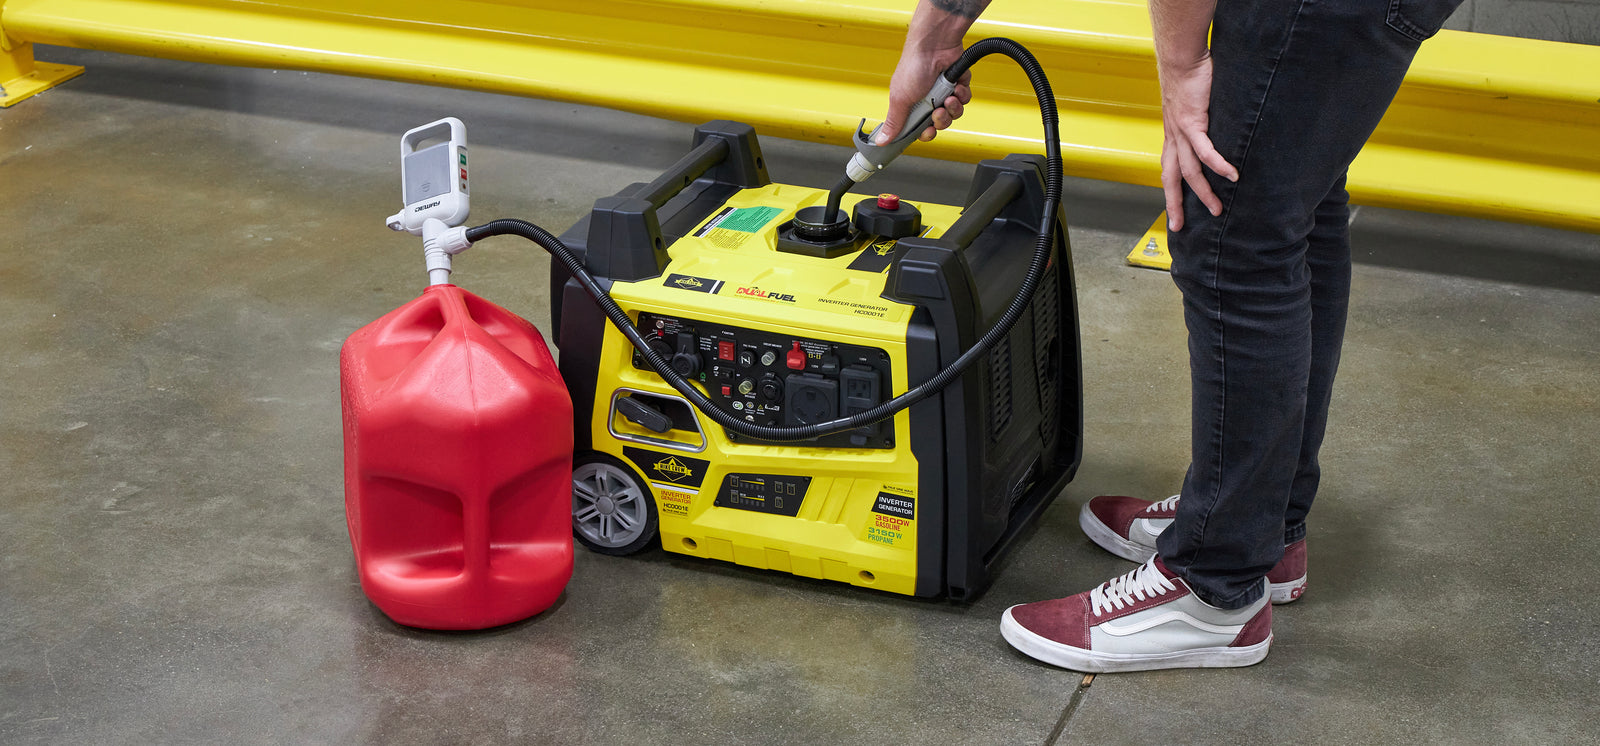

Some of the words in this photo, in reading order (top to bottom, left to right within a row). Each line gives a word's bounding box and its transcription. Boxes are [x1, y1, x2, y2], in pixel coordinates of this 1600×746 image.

[736, 287, 767, 298] DUAL
[767, 292, 796, 302] FUEL
[818, 298, 849, 306] INVERTER
[850, 302, 888, 312] GENERATOR
[661, 490, 691, 500] INVERTER
[661, 495, 691, 504] GENERATOR
[879, 496, 912, 509] INVERTER
[878, 504, 912, 515] GENERATOR
[875, 520, 901, 531] GASOLINE
[868, 533, 894, 545] PROPANE
